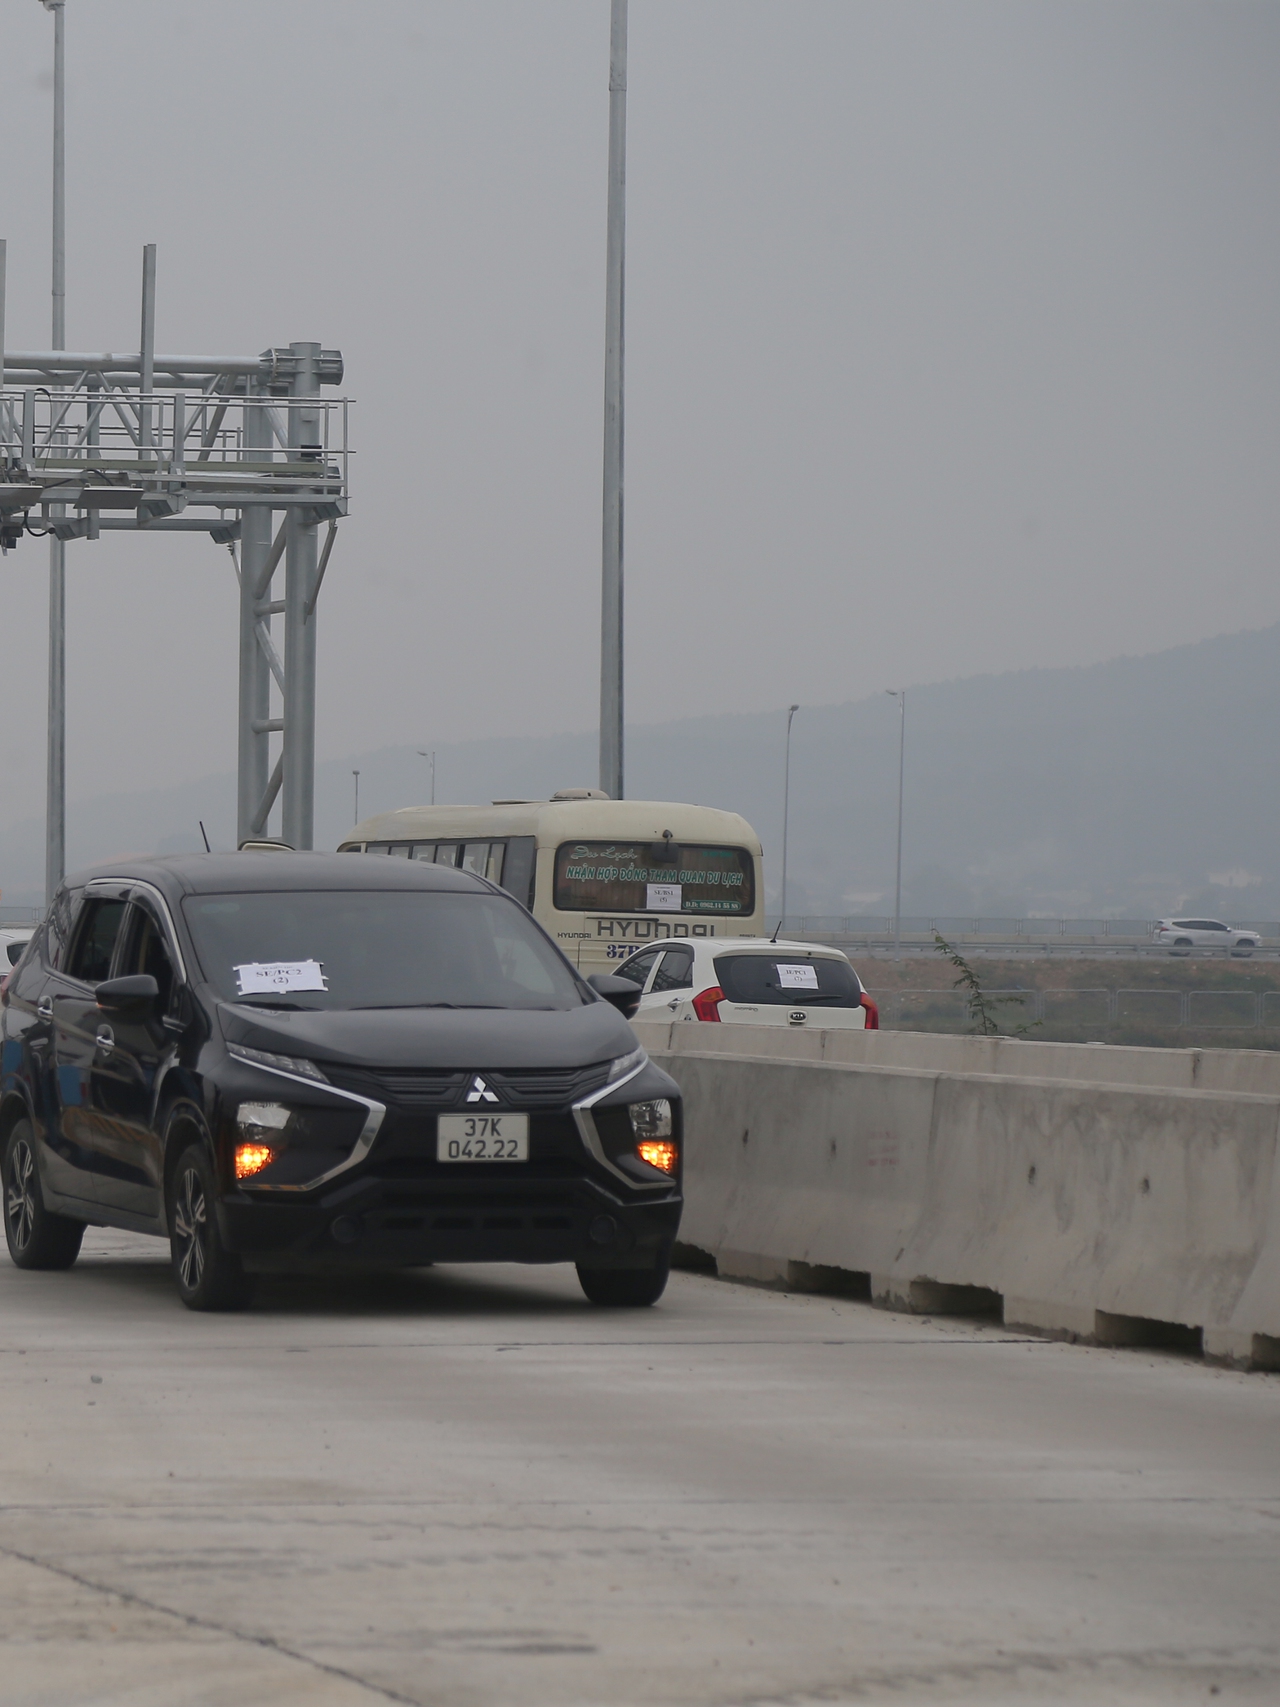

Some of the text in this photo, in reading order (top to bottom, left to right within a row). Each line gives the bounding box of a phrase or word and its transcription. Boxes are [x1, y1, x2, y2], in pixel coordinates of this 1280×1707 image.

[566, 863, 595, 883] NHẬN
[597, 865, 618, 884] HỢP
[649, 869, 677, 883] THAM
[679, 870, 705, 885] QUAN
[722, 872, 743, 888] LỊCH
[597, 920, 714, 938] HYUNDAI
[256, 969, 302, 977] SE/PC2
[273, 976, 289, 984] (2)
[465, 1117, 502, 1137] 37K
[448, 1139, 518, 1158] 042.22
